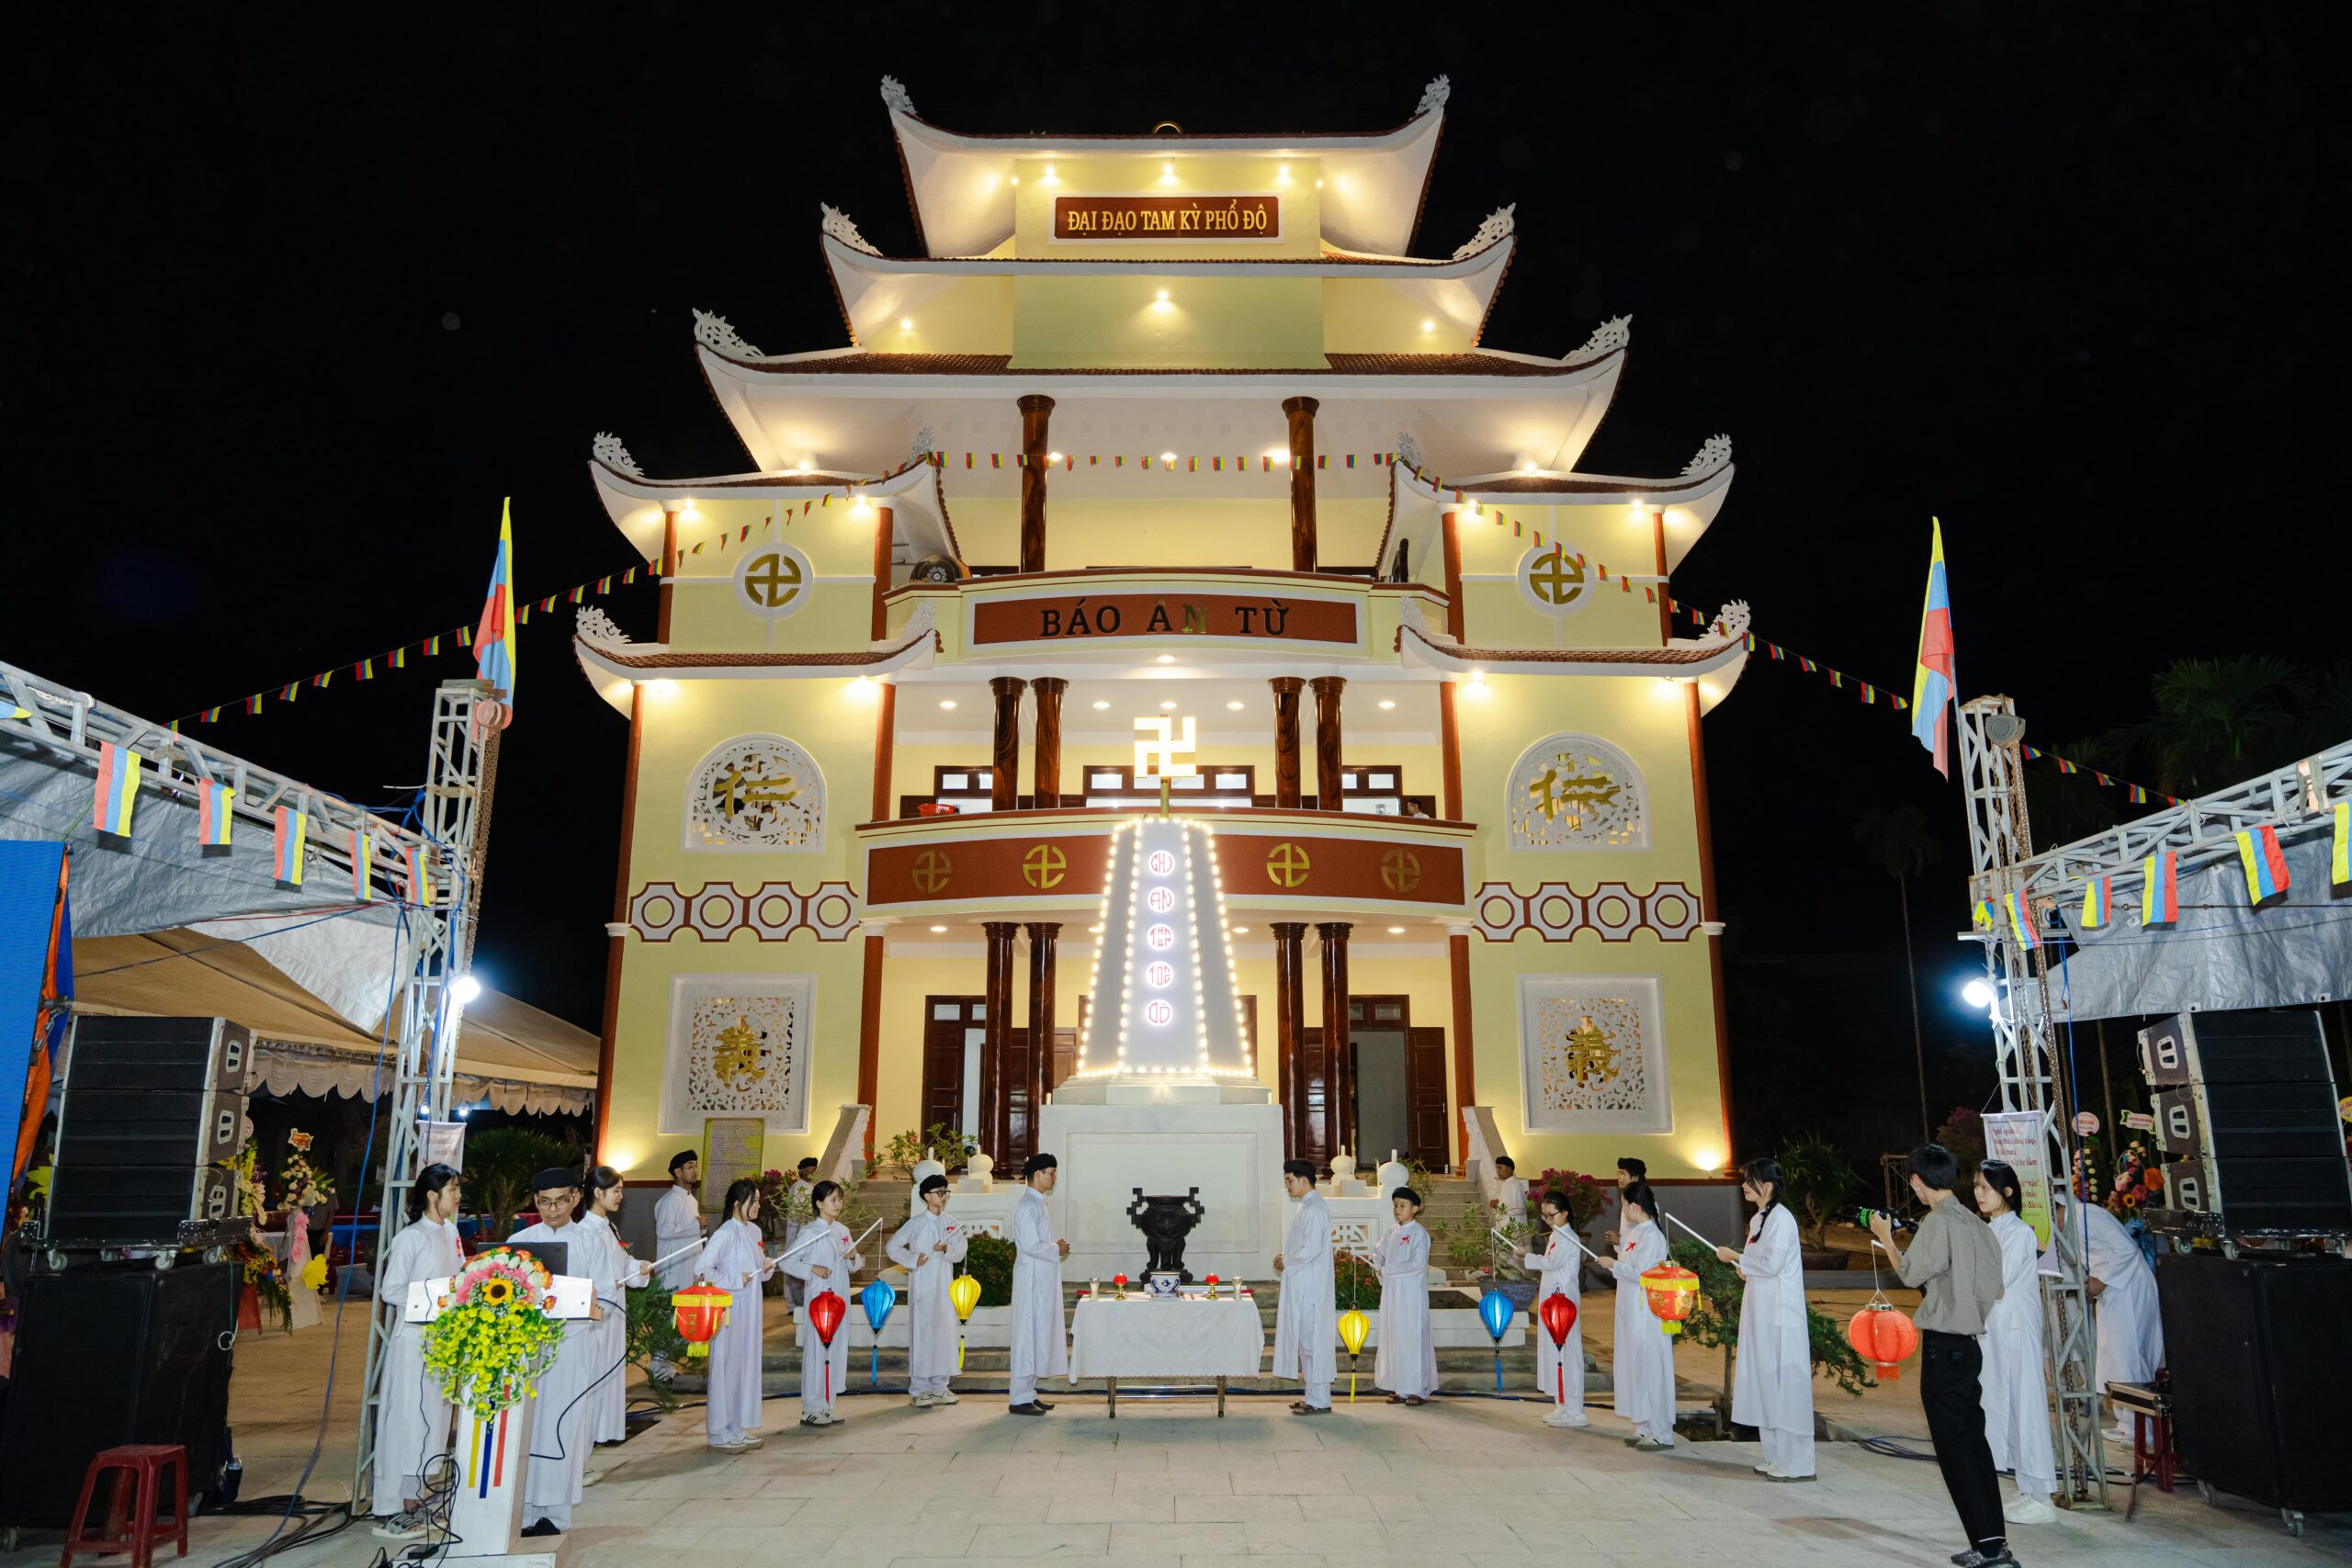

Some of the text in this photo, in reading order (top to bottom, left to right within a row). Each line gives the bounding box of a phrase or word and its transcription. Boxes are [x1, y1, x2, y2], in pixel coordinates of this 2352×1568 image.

[1068, 198, 1268, 236] ĐẠI ĐẠO TAM KỲ PHỔ ĐỘ
[1040, 597, 1121, 637] BÁO
[1234, 598, 1290, 636] TỪ
